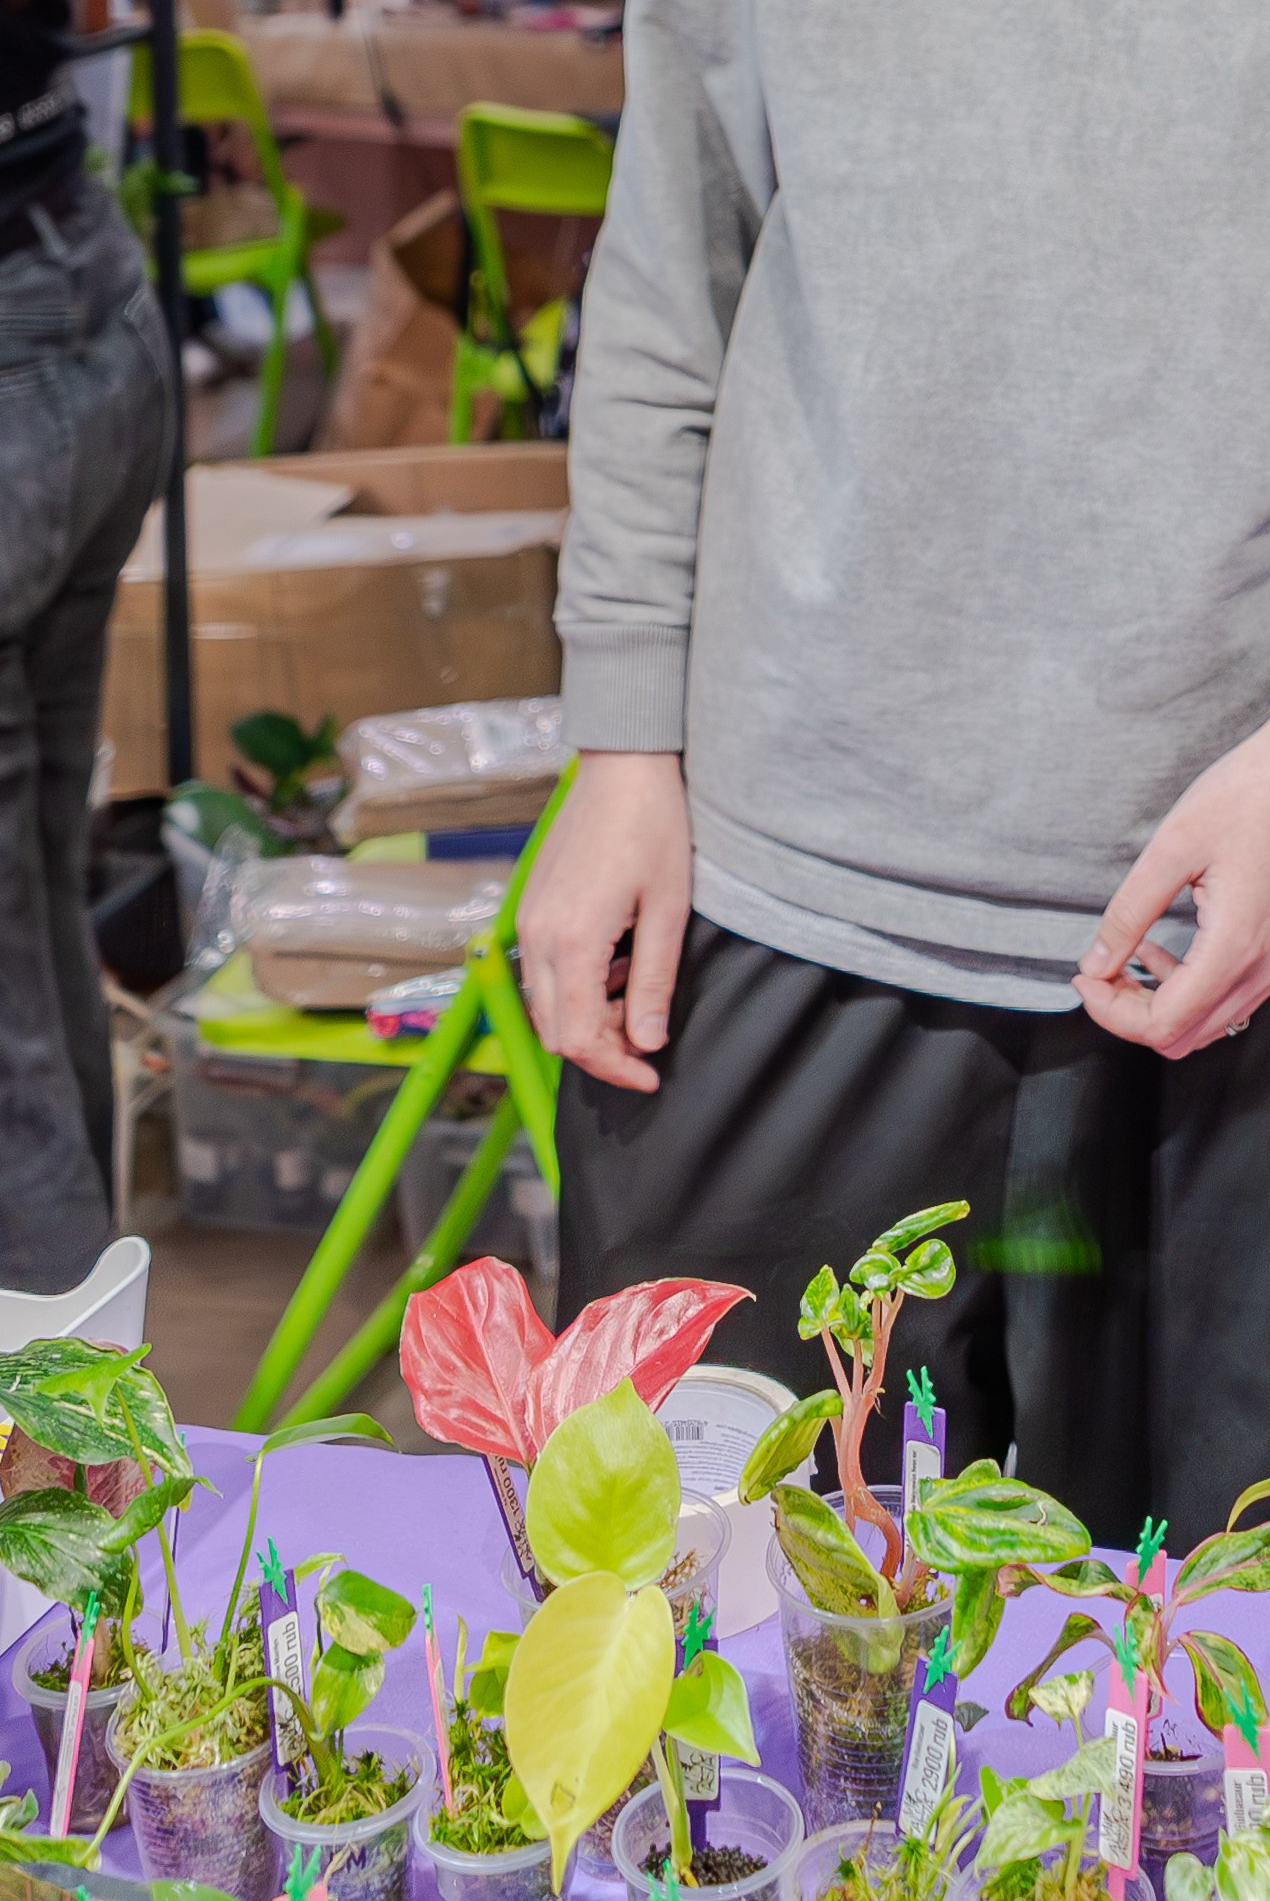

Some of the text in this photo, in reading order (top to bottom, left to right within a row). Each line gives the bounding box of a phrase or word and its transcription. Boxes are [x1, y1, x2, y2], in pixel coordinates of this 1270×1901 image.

[495, 1455, 508, 1474] ru
[283, 1653, 301, 1696] 500
[1121, 1720, 1136, 1750] rub
[922, 1718, 948, 1792] 2900 rub
